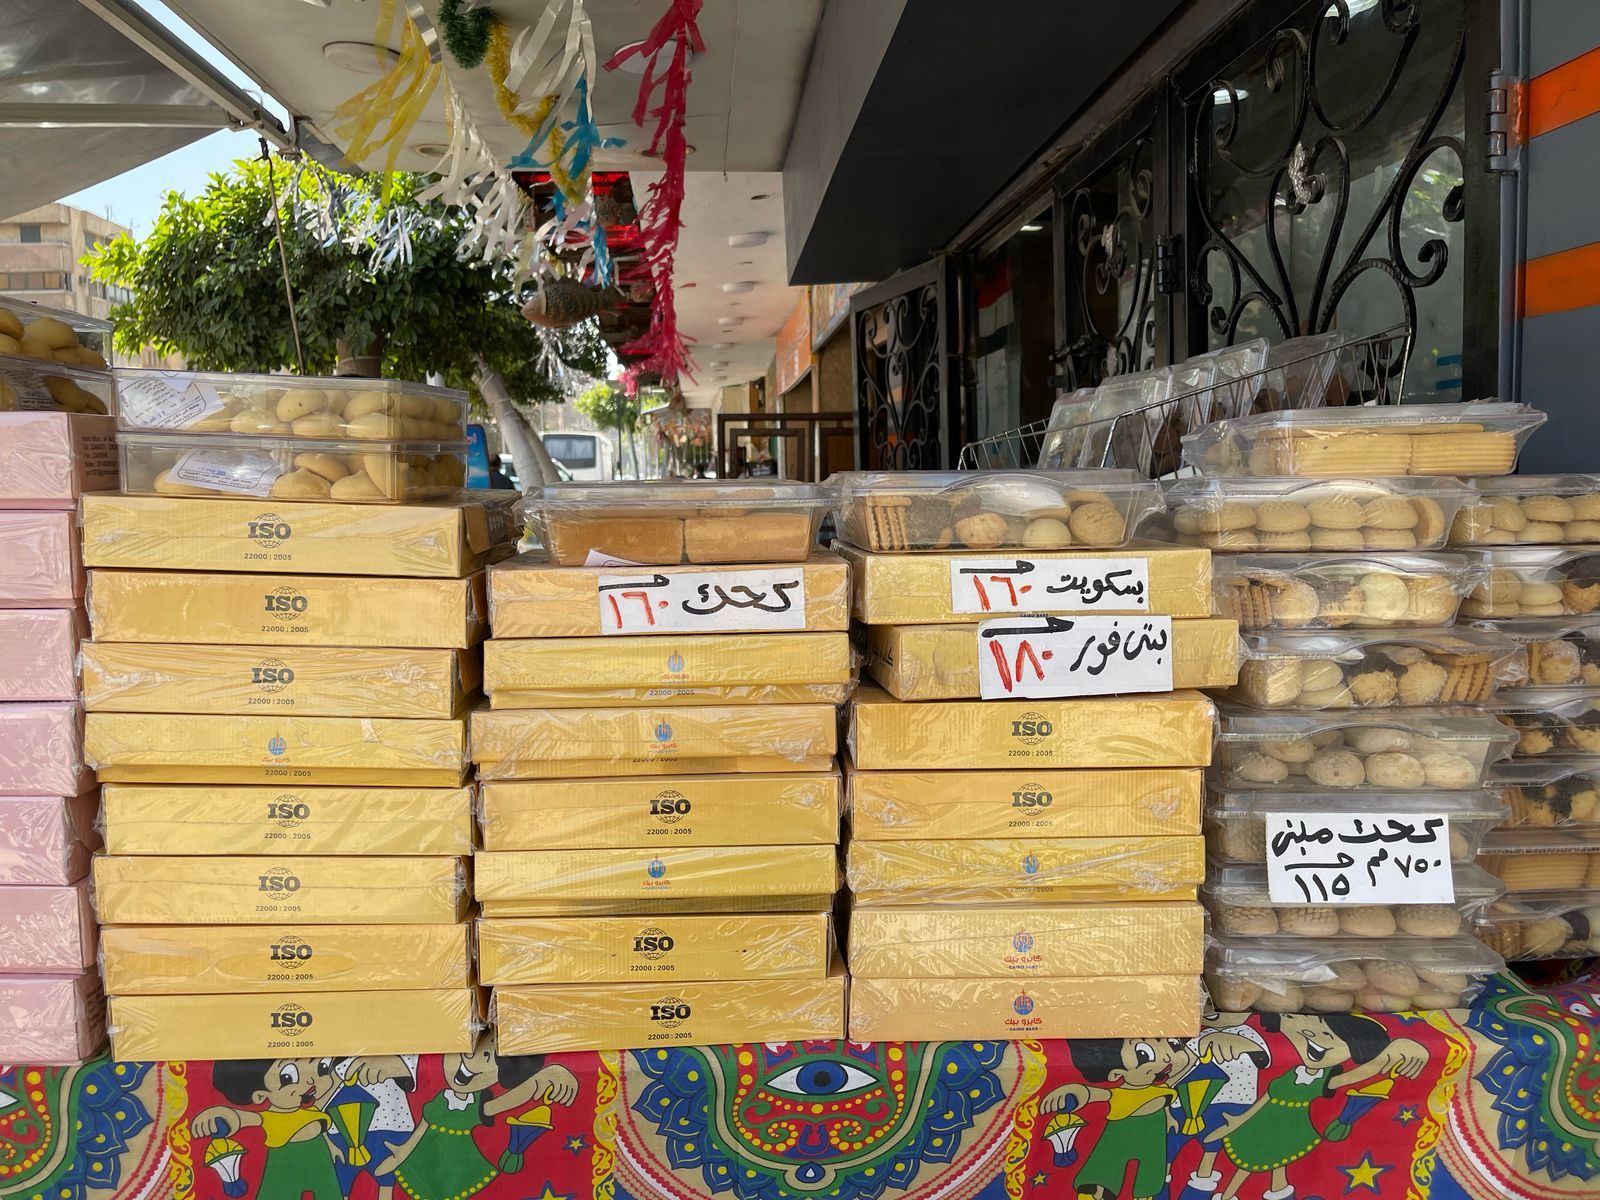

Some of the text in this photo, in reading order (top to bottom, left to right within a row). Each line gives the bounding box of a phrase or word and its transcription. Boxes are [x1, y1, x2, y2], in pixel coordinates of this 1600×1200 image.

[247, 522, 292, 540] ISO
[1046, 569, 1144, 604] بسكويت
[264, 595, 308, 612] ISO
[682, 580, 800, 615] كحك
[1069, 621, 1121, 675] فور
[251, 667, 295, 684] ISO
[1011, 721, 1053, 736] ISO
[650, 799, 692, 815] ISO
[1011, 791, 1053, 807] ISO
[267, 803, 310, 819] ISO
[258, 875, 301, 892] ISO
[633, 936, 674, 951] ISO
[270, 944, 313, 961] ISO
[1004, 955, 1043, 963] كايرو بيك
[271, 1012, 313, 1028] ISO
[650, 1004, 692, 1020] ISO
[1004, 1018, 1043, 1026] كايرو بيك
